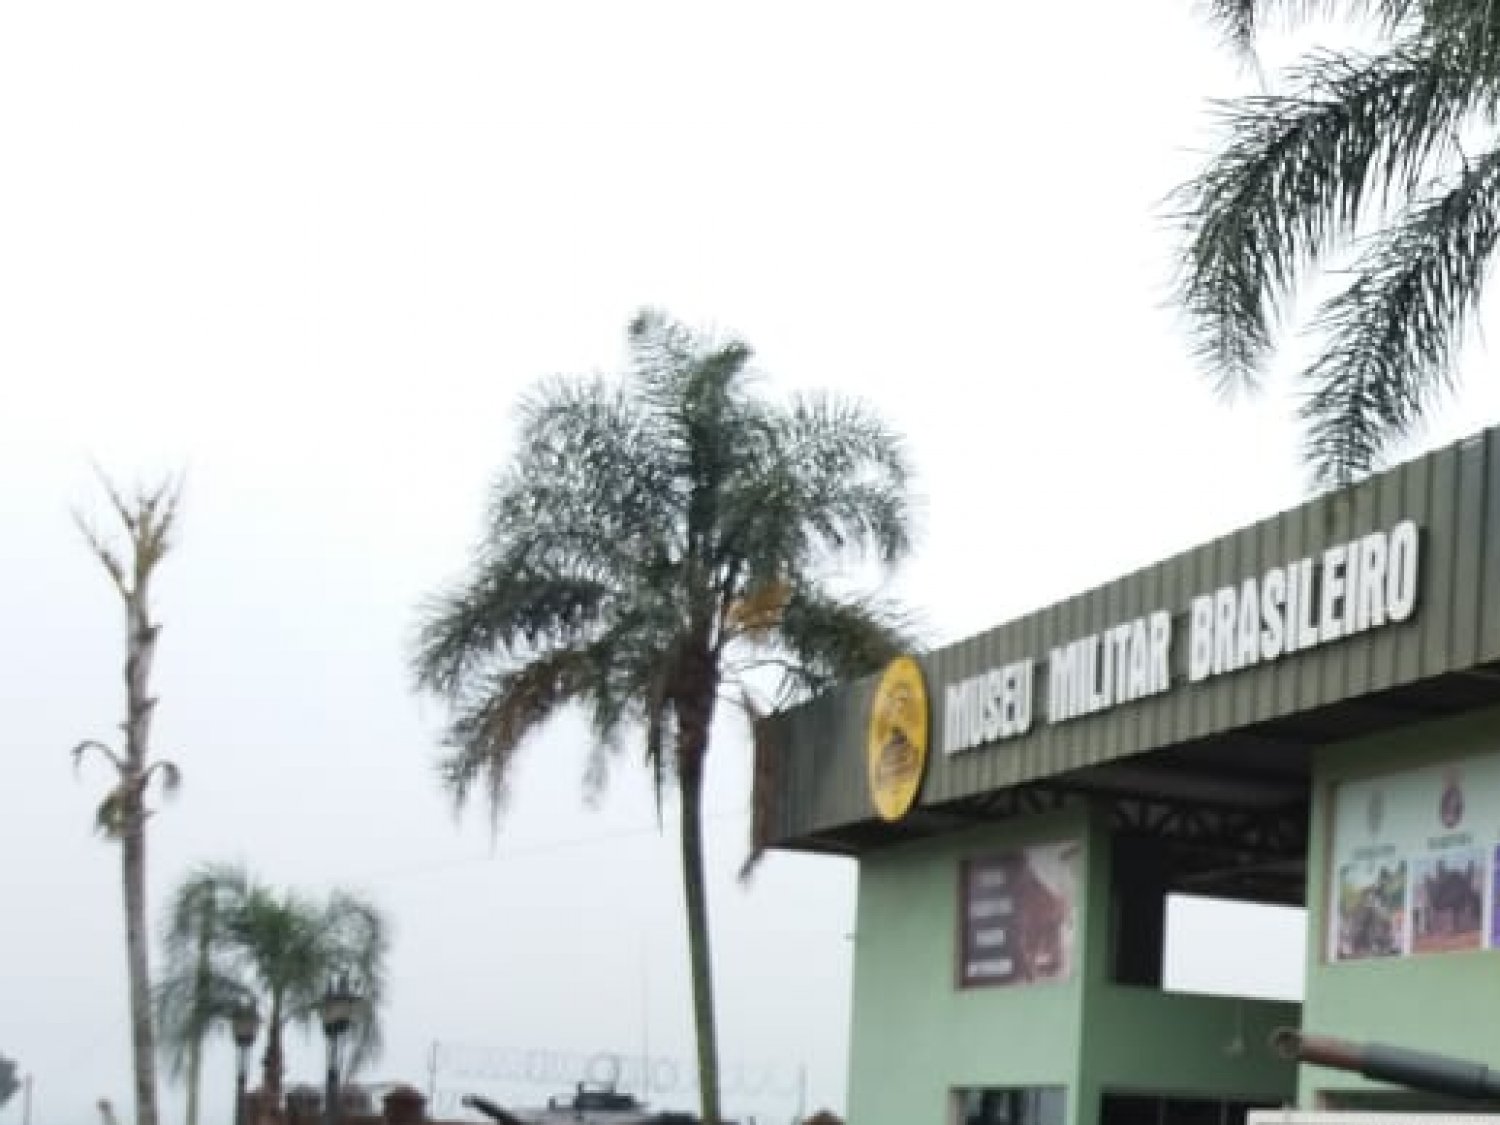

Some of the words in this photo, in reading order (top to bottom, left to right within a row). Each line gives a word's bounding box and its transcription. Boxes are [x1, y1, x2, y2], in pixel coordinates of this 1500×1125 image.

[944, 658, 1033, 755] MUSEU
[1048, 610, 1172, 724] MILITAR
[1189, 519, 1420, 681] BRASILEIRO
